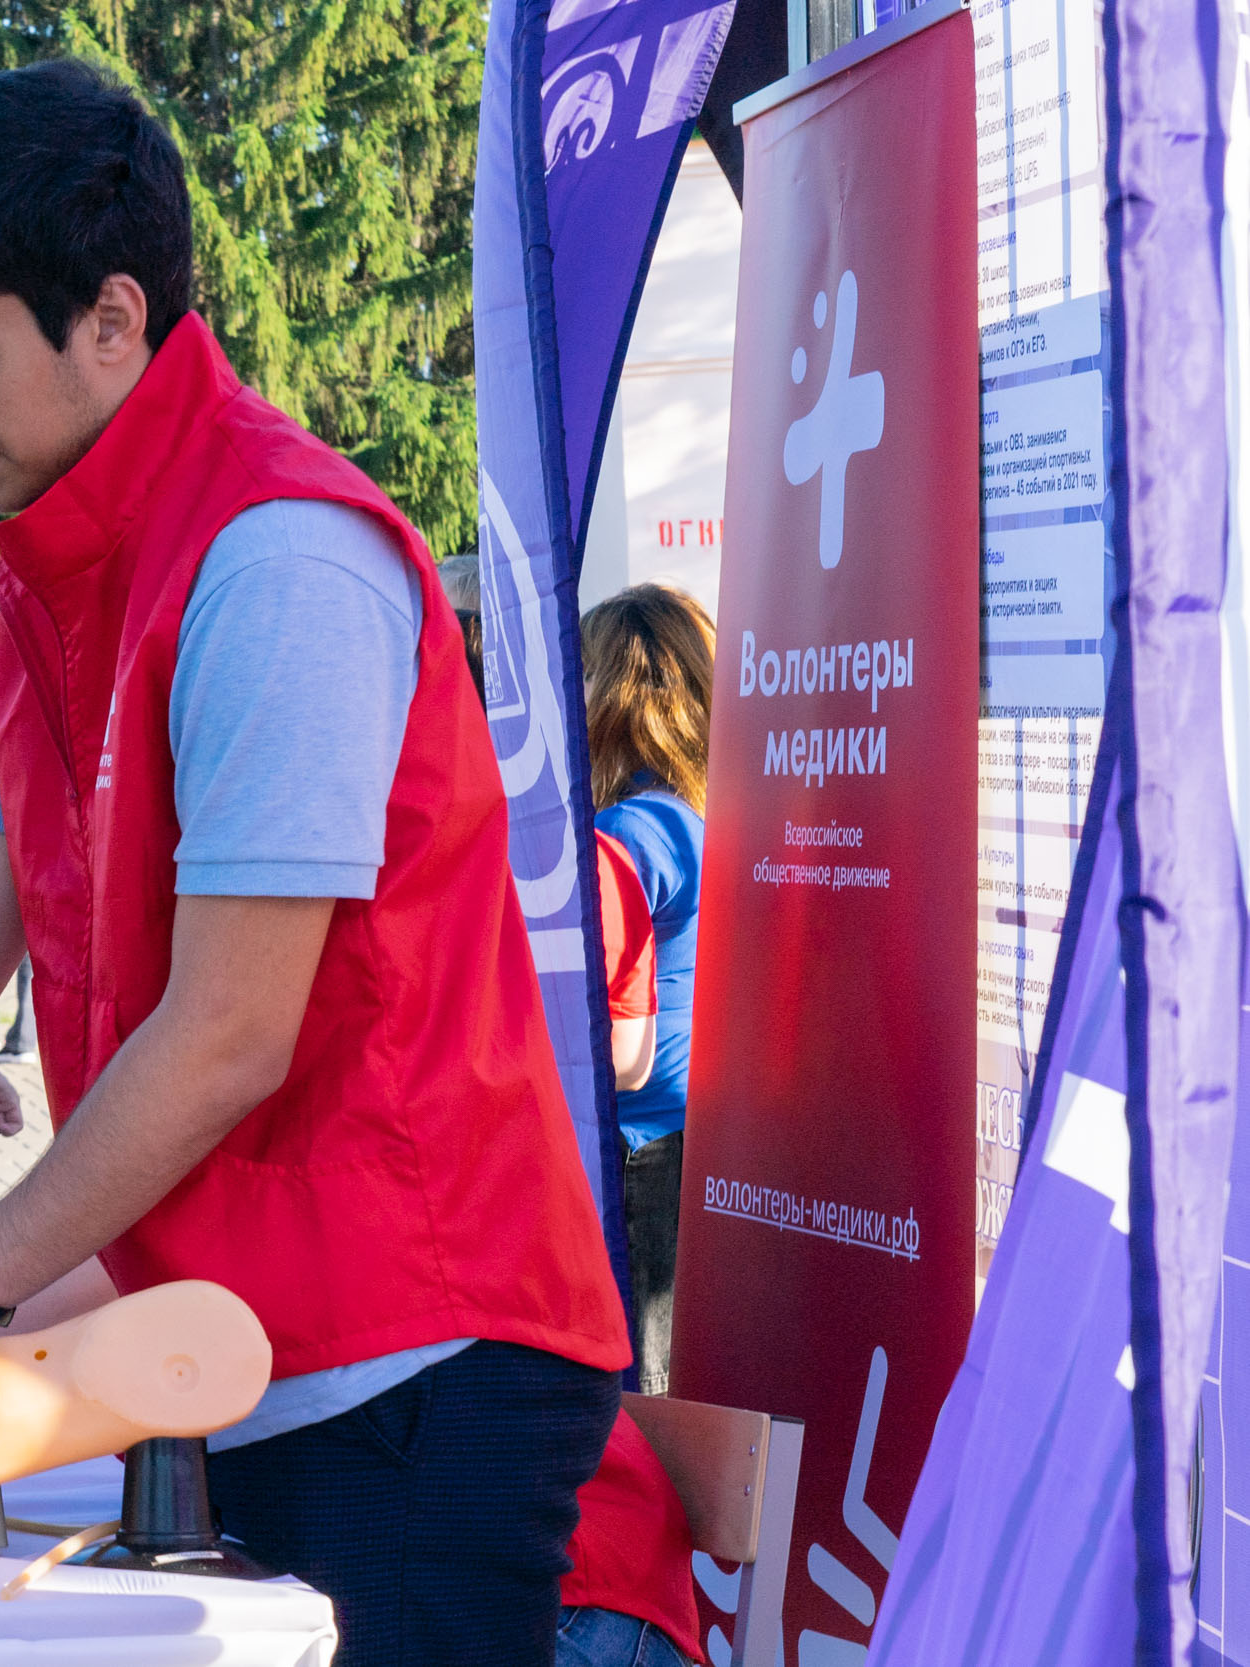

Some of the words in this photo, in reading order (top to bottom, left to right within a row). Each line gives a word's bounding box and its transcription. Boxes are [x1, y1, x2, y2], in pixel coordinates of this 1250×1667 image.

[1011, 339, 1025, 358] ОГЭ
[1027, 429, 1067, 448] занимаемся
[1002, 452, 1047, 479] организацией
[1049, 449, 1091, 471] спортивных
[1016, 480, 1024, 496] 45
[1026, 475, 1055, 494] событий
[1063, 472, 1079, 490] 2021
[1035, 577, 1058, 594] акциях
[992, 600, 1036, 620] исторической
[739, 629, 914, 713] Волонтеры
[1032, 706, 1061, 724] культуру
[763, 726, 887, 788] медики
[784, 819, 863, 851] Всероссийское
[753, 856, 830, 888] общественное
[832, 866, 890, 892] движение
[1034, 883, 1064, 901] события
